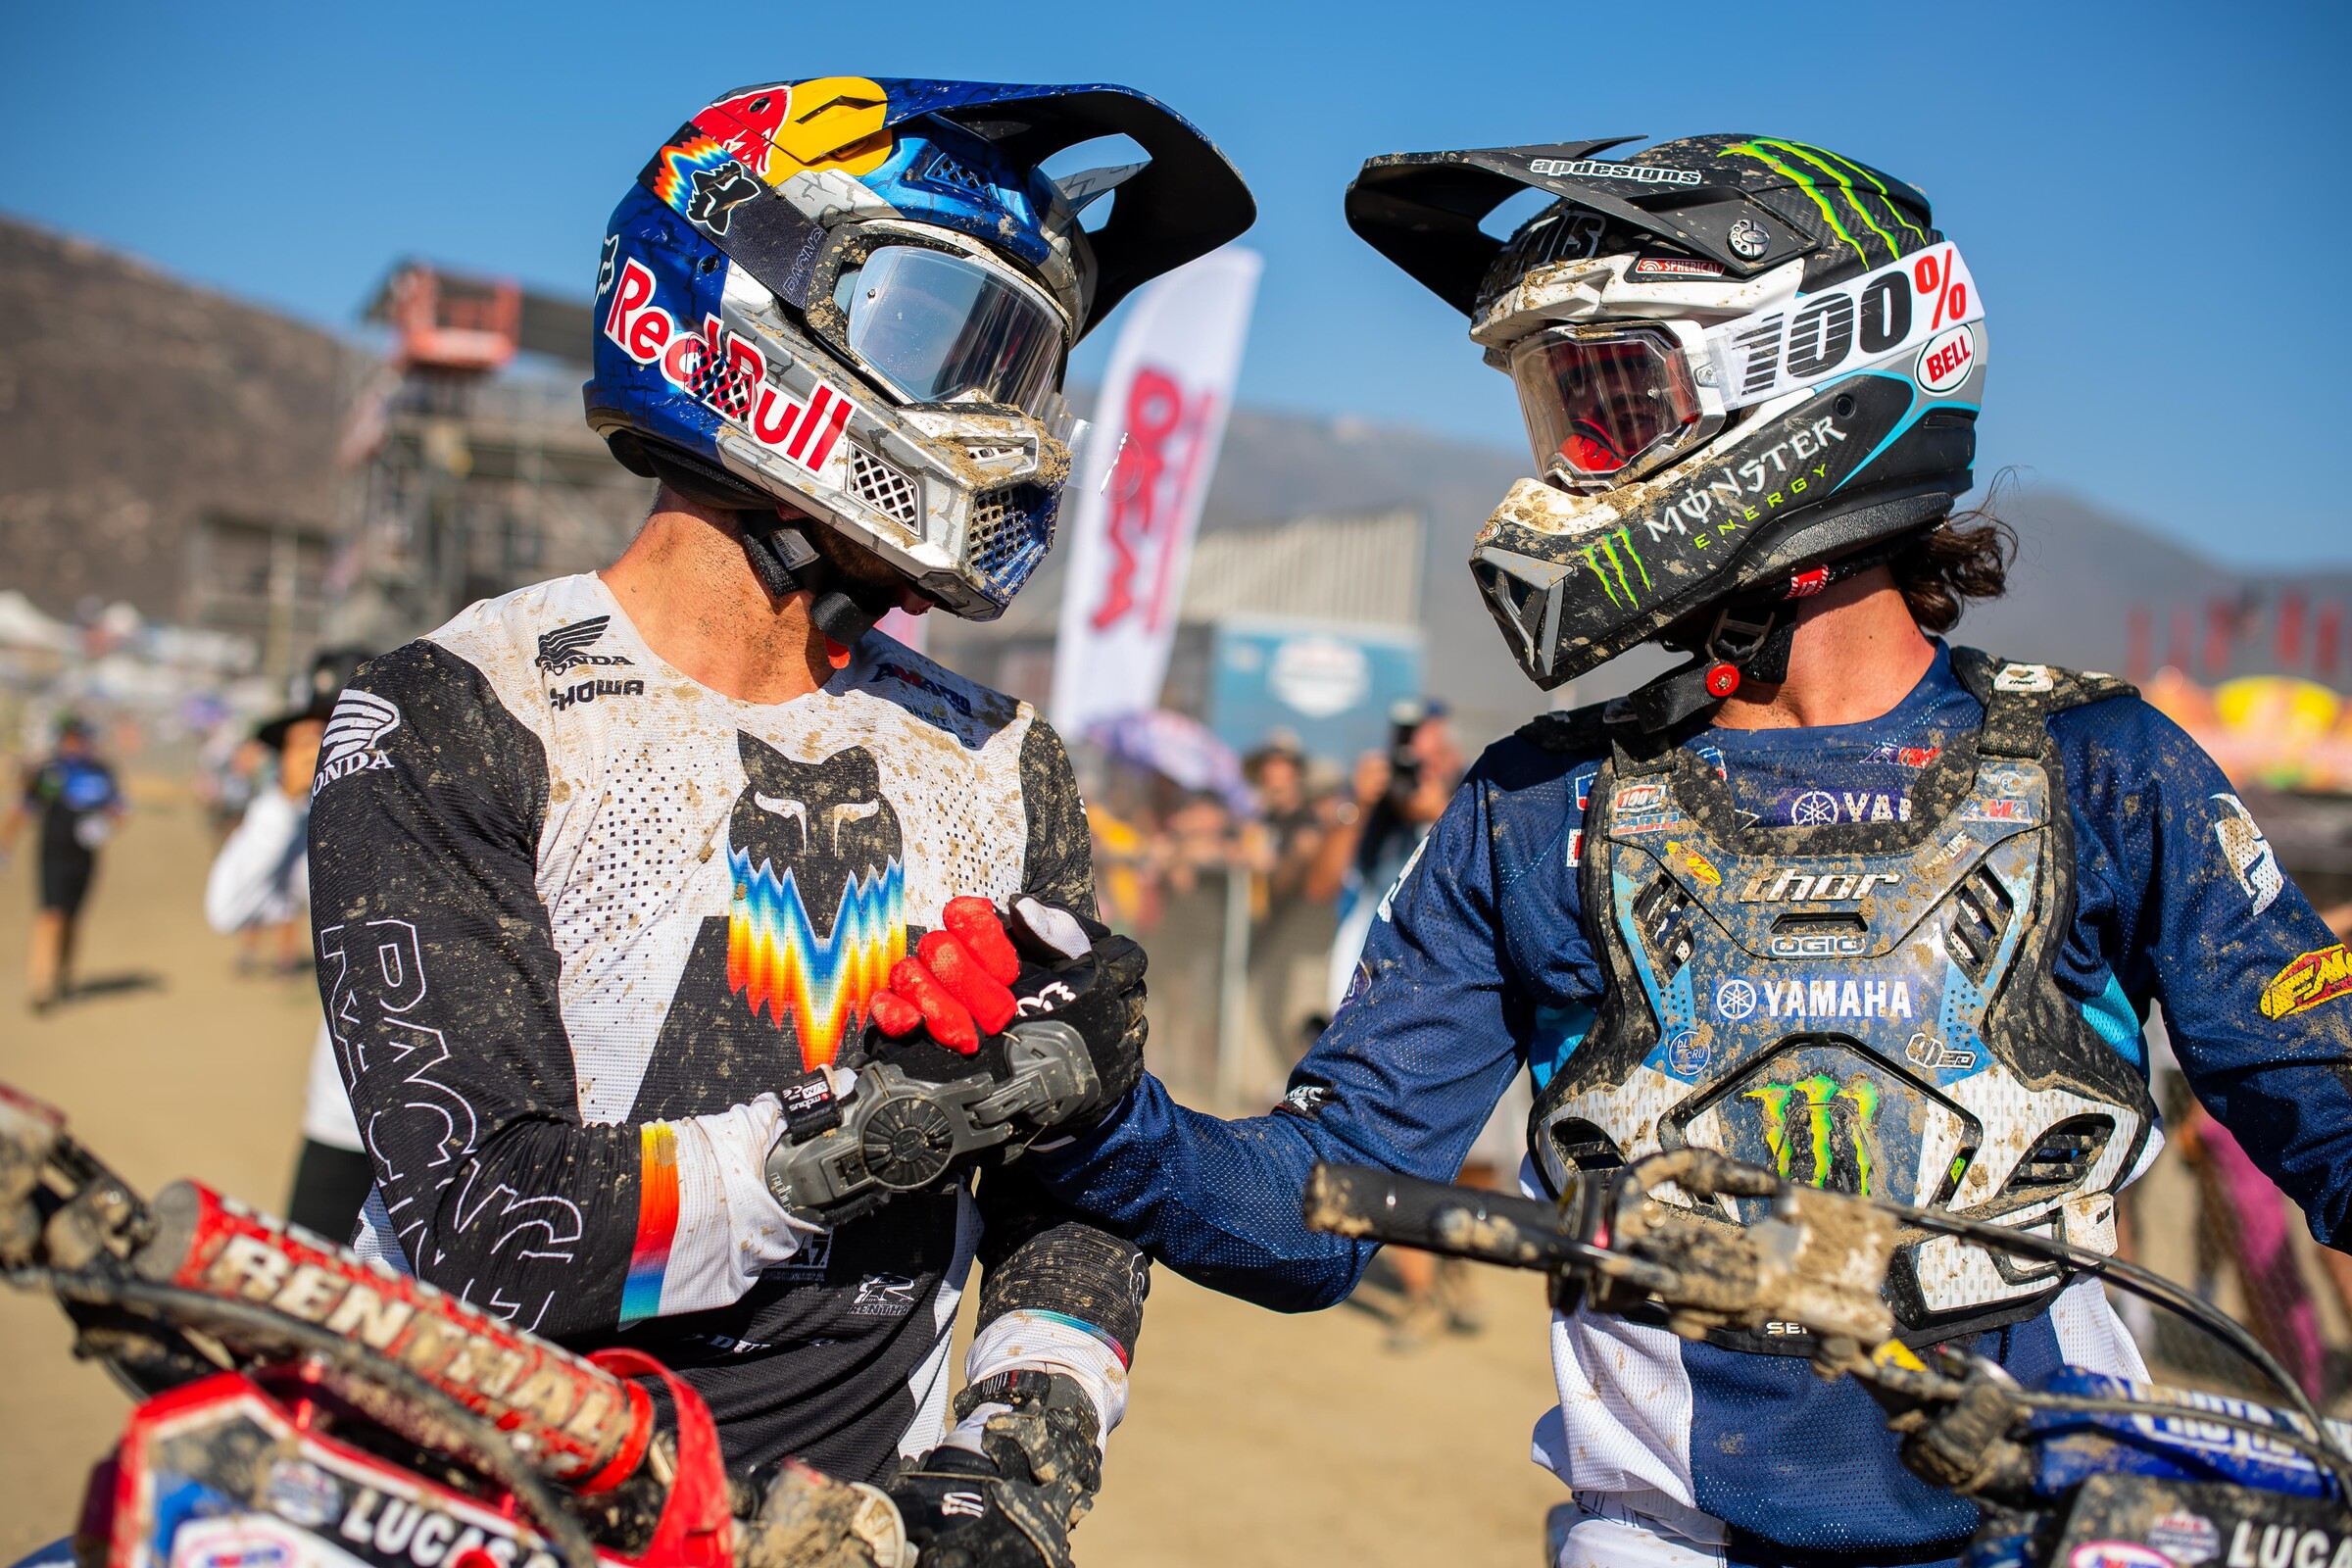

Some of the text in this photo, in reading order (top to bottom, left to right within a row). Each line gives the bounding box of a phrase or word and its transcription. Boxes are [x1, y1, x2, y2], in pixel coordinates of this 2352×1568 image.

[1531, 159, 1702, 185] apdesigns
[1664, 260, 1722, 273] SPHERICAL
[1731, 247, 1968, 397] 100%
[607, 263, 854, 472] Red Bull
[1926, 334, 1972, 383] BELL
[1643, 415, 1847, 544] MONSTER
[1693, 463, 1828, 551] ENERGY
[312, 749, 395, 801] ONDA
[1771, 935, 1866, 956] OGIO
[1764, 978, 1912, 1019] YAMAHA
[2272, 948, 2352, 1021] FM
[789, 1095, 822, 1112] mobius
